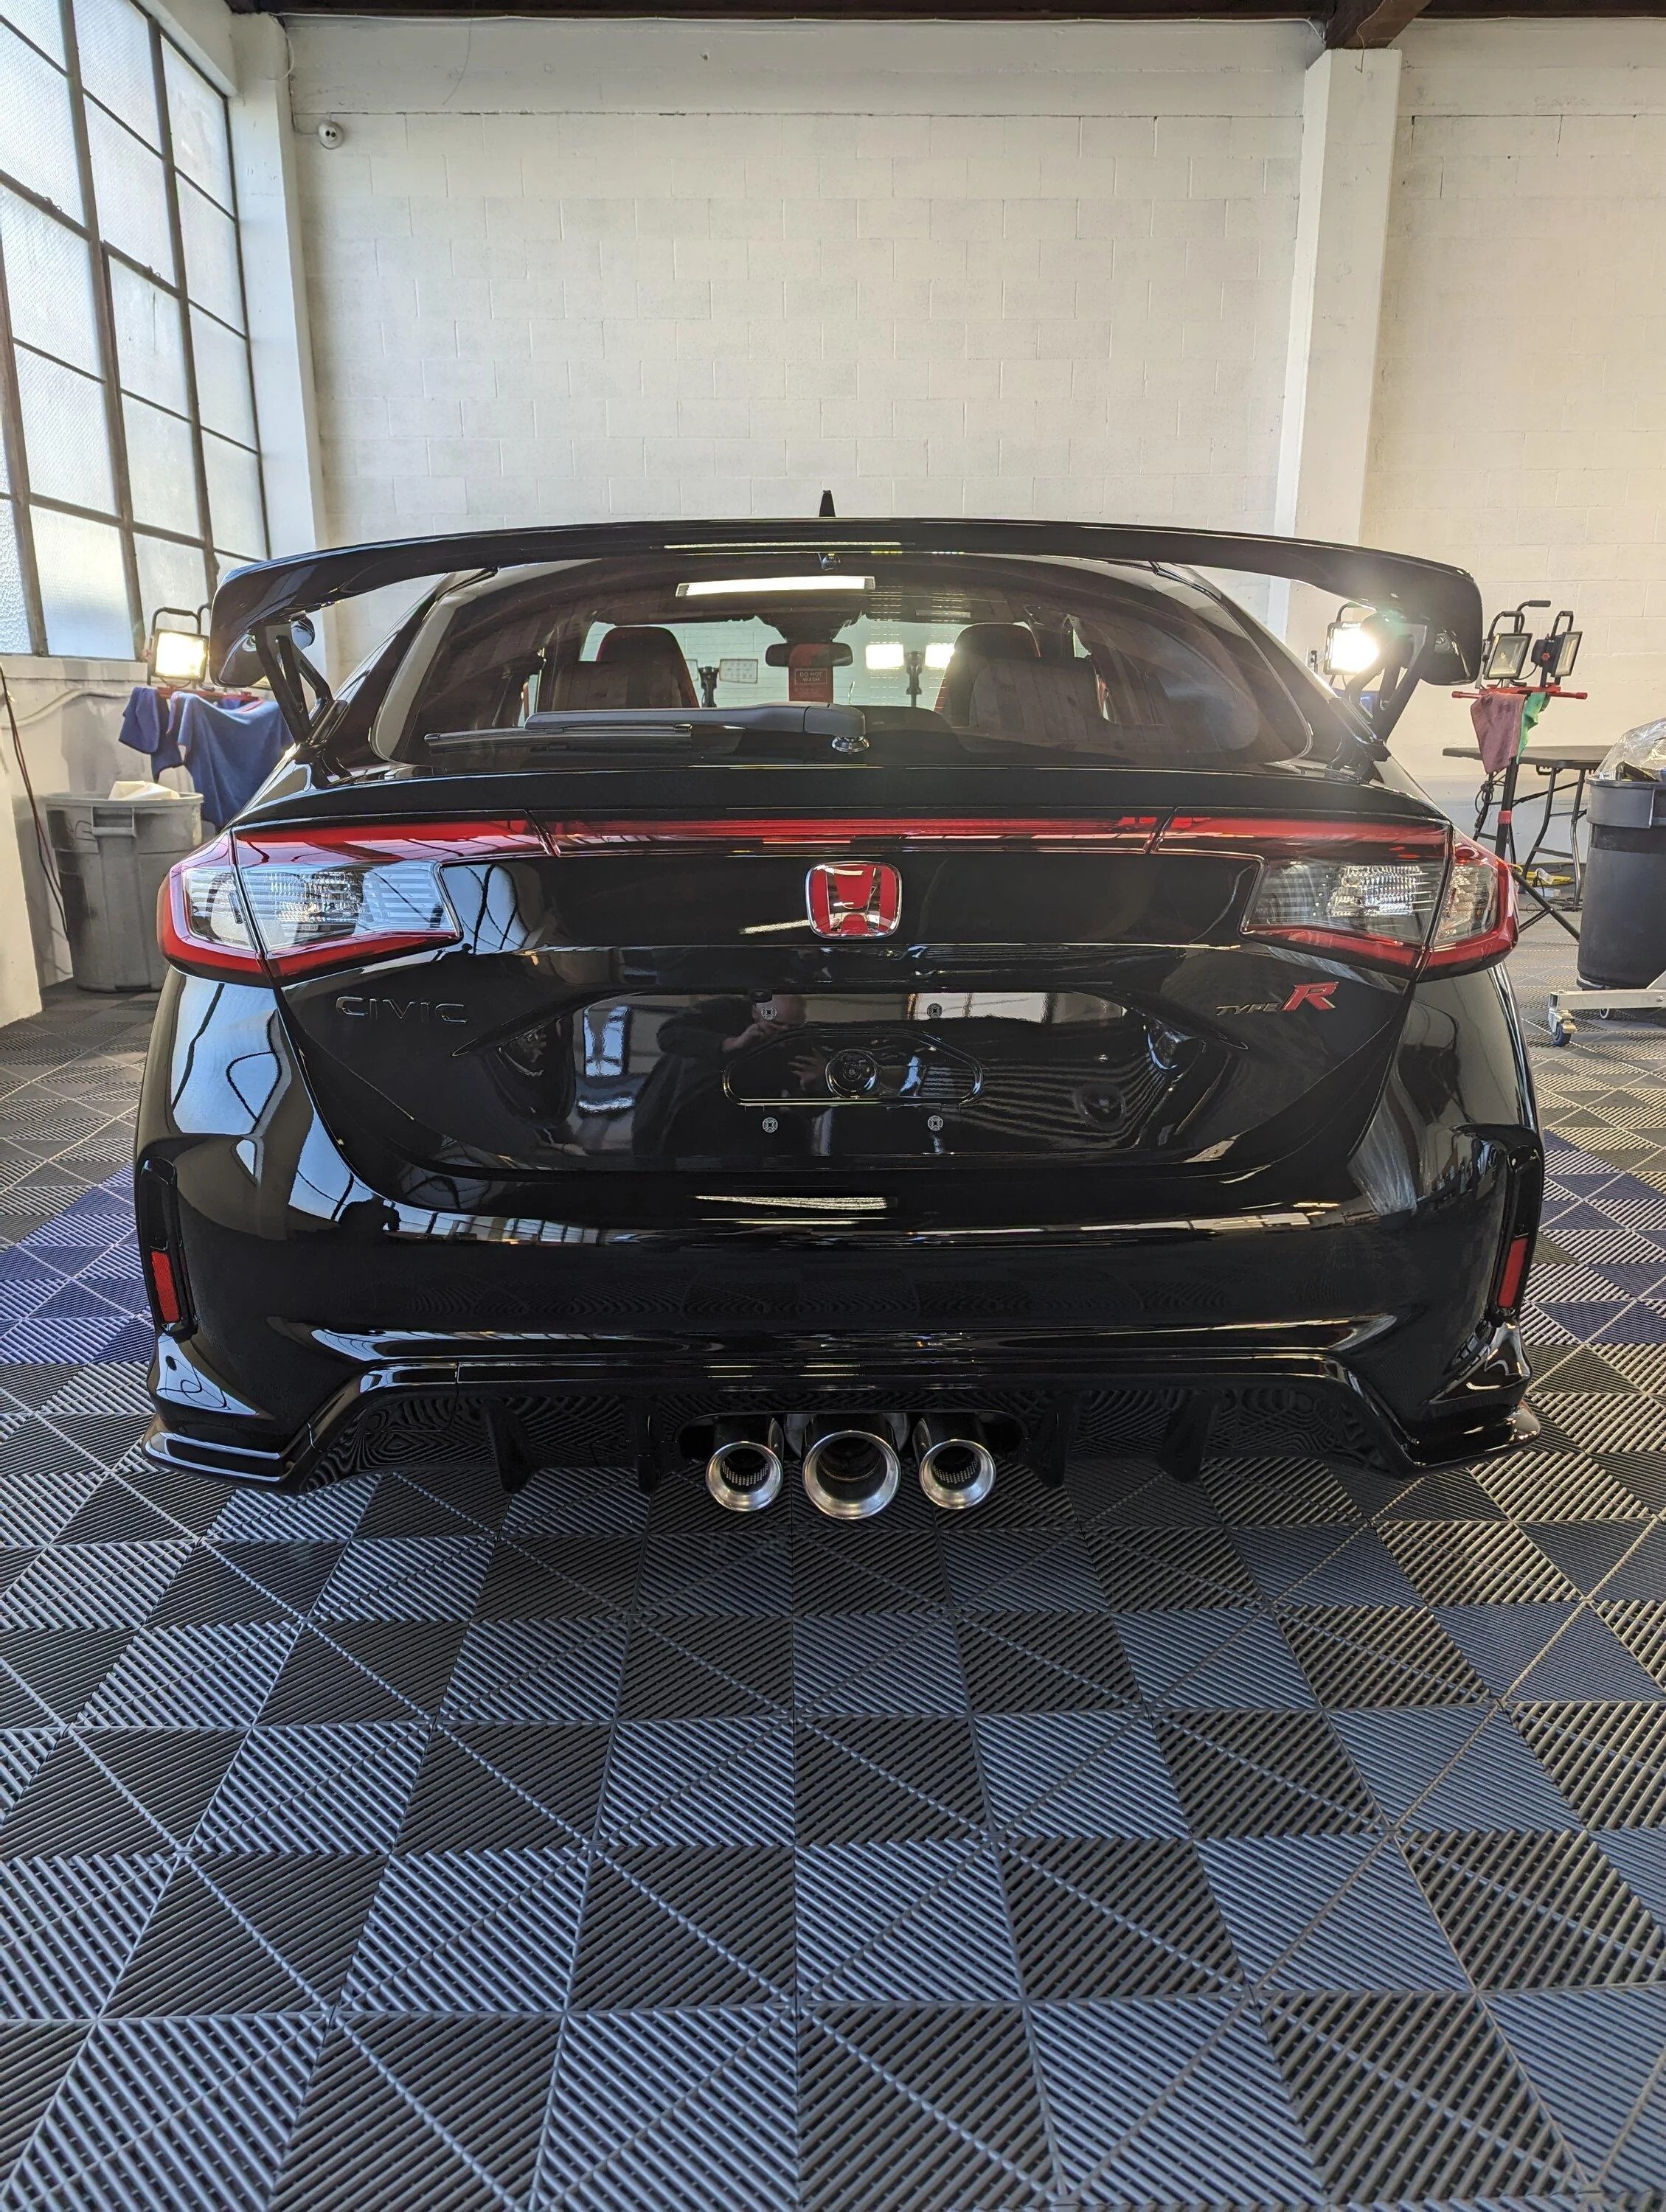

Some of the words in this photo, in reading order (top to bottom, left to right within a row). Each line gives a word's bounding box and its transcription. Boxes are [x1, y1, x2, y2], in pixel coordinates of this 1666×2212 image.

[336, 996, 468, 1023] CIVIC
[1216, 1003, 1280, 1015] TYPE
[1282, 981, 1339, 1011] R
